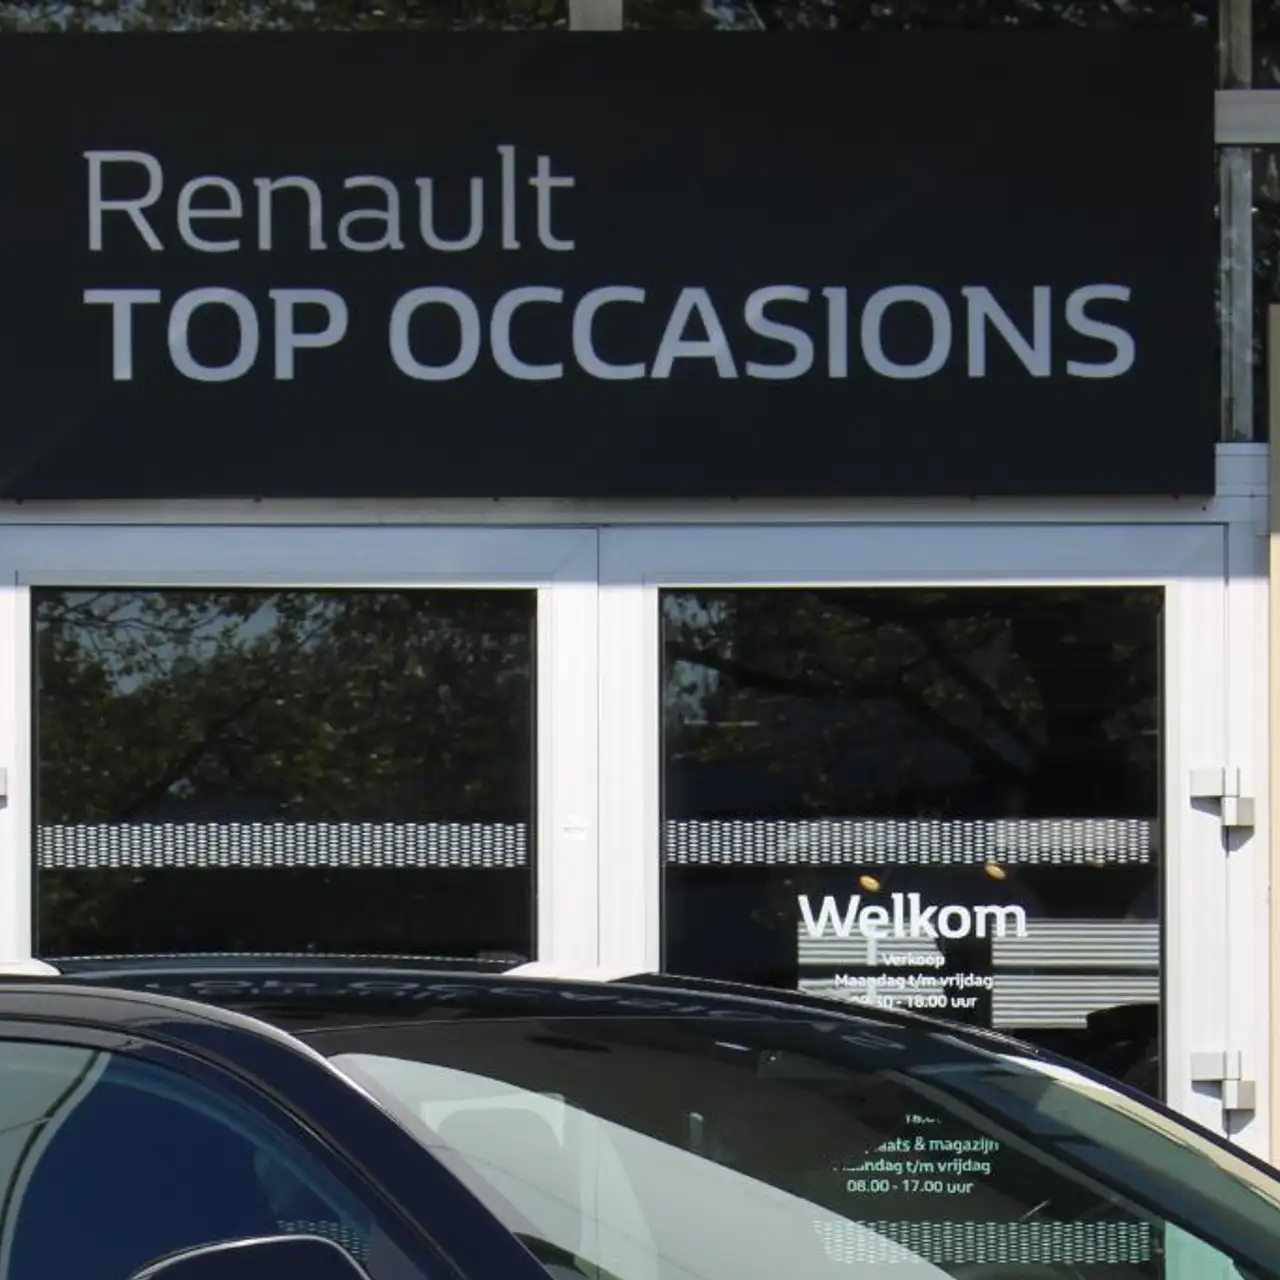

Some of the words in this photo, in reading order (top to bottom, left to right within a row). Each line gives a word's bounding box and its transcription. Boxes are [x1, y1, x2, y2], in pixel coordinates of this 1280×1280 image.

[82, 143, 576, 252] Renault
[82, 286, 349, 382] TOP
[388, 284, 1138, 381] OCCASIONS
[797, 892, 1028, 939] Welkom
[882, 953, 945, 968] Verkoop
[834, 973, 905, 989] Maandag
[907, 974, 936, 988] t/m
[938, 973, 993, 989] vrijdag
[908, 995, 948, 1008] 18.00
[951, 997, 977, 1008] uur
[929, 1136, 999, 1154] magazijn
[906, 1159, 934, 1173] t/m
[937, 1158, 991, 1175] vrijdag
[847, 1180, 889, 1192] 08.00
[902, 1179, 943, 1192] 17.00
[946, 1182, 973, 1194] uur
